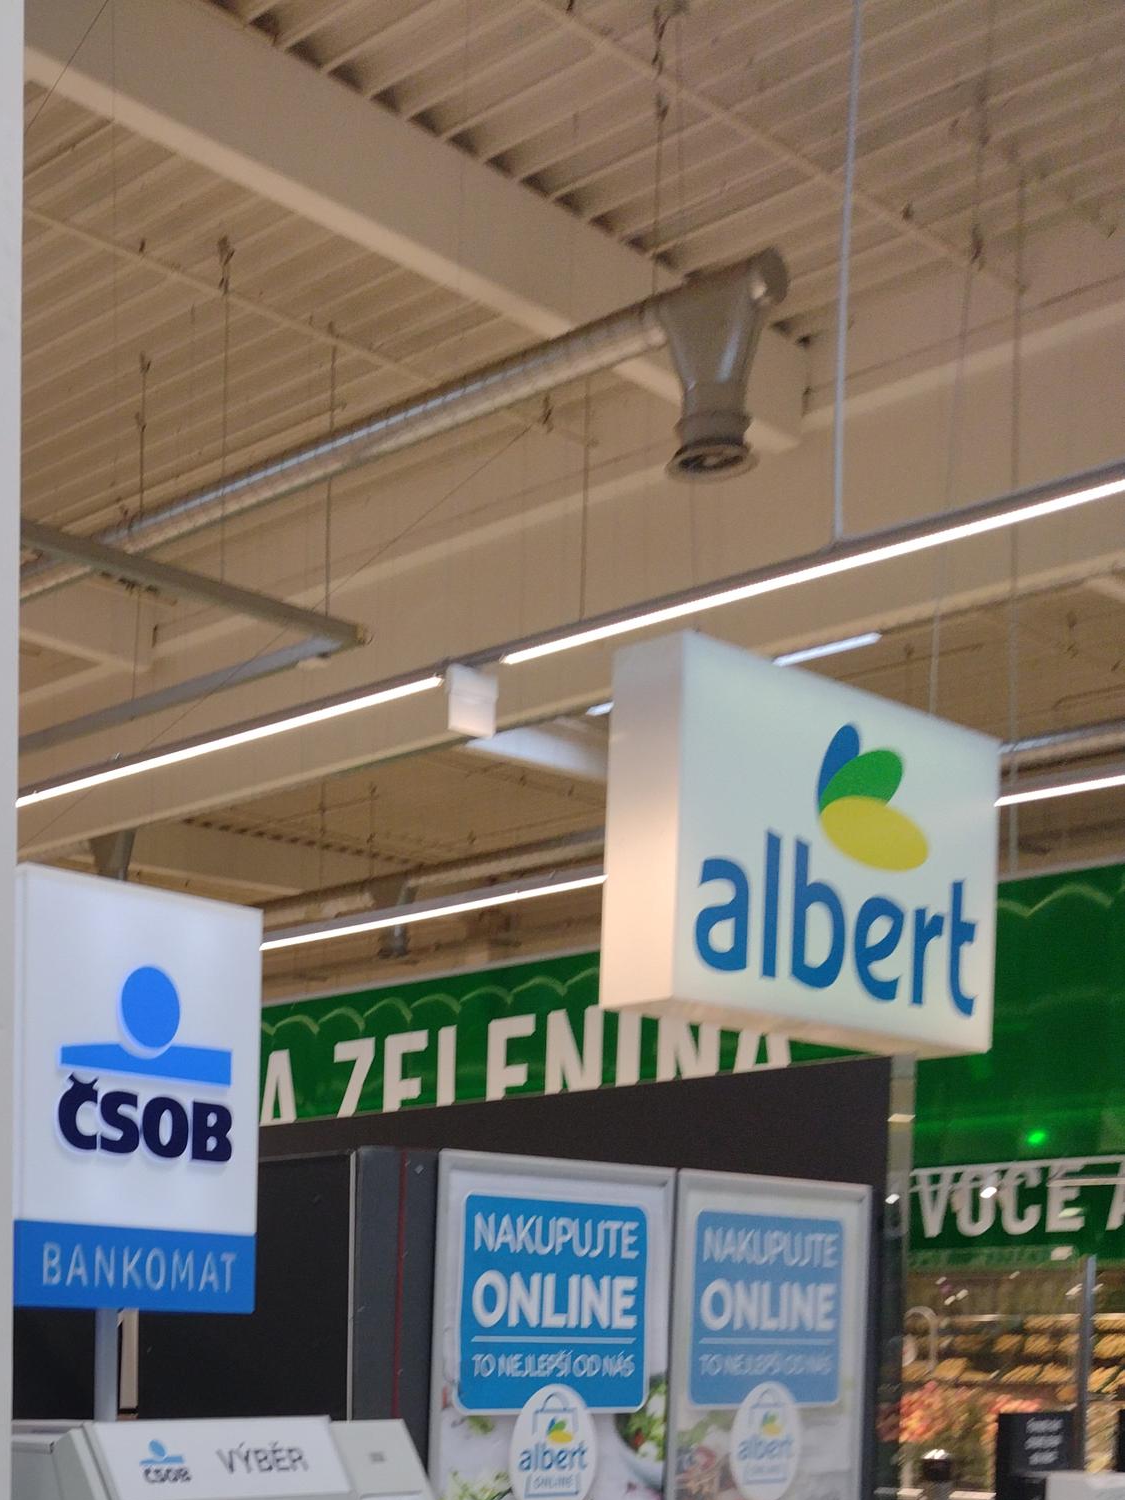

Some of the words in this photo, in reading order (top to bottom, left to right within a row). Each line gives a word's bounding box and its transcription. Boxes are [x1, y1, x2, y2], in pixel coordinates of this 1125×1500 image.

[693, 830, 979, 1018] albert
[57, 1072, 233, 1163] ČSOB
[474, 1211, 640, 1260] NAKUPUJTE
[702, 1226, 840, 1268] NAKUPUJTE
[42, 1242, 236, 1293] BANKOMAT
[472, 1269, 638, 1330] ONLINE
[700, 1277, 837, 1332] ONLINE
[472, 1353, 496, 1377] TO
[216, 1441, 309, 1474] VÝBĚR
[518, 1441, 589, 1472] albert
